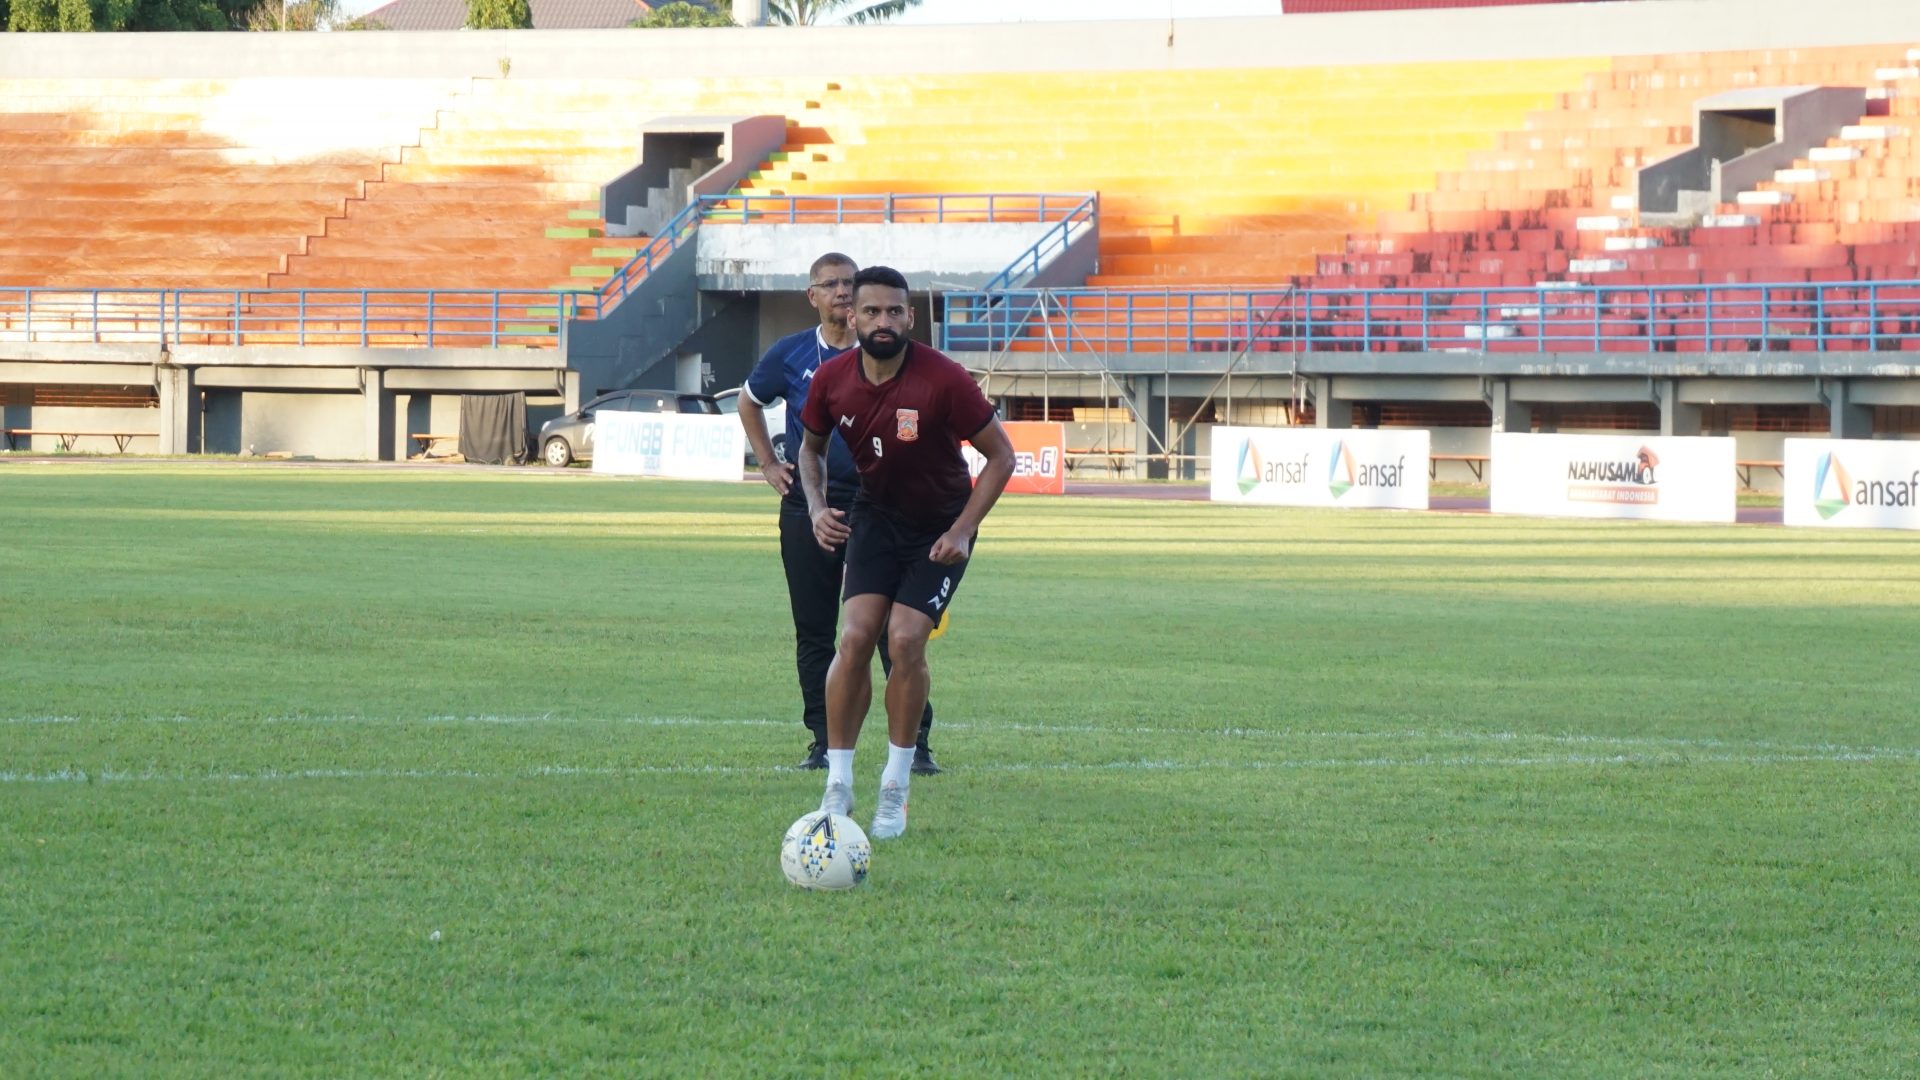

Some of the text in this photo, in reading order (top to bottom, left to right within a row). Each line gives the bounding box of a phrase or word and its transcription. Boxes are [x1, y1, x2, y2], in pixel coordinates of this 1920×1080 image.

[605, 421, 664, 455] FUN88
[672, 424, 734, 459] FUN88
[872, 436, 883, 458] 9
[1265, 453, 1310, 483] ansaf
[1358, 455, 1405, 487] ansaf
[1856, 470, 1920, 507] ansaf
[940, 576, 951, 598] 9
